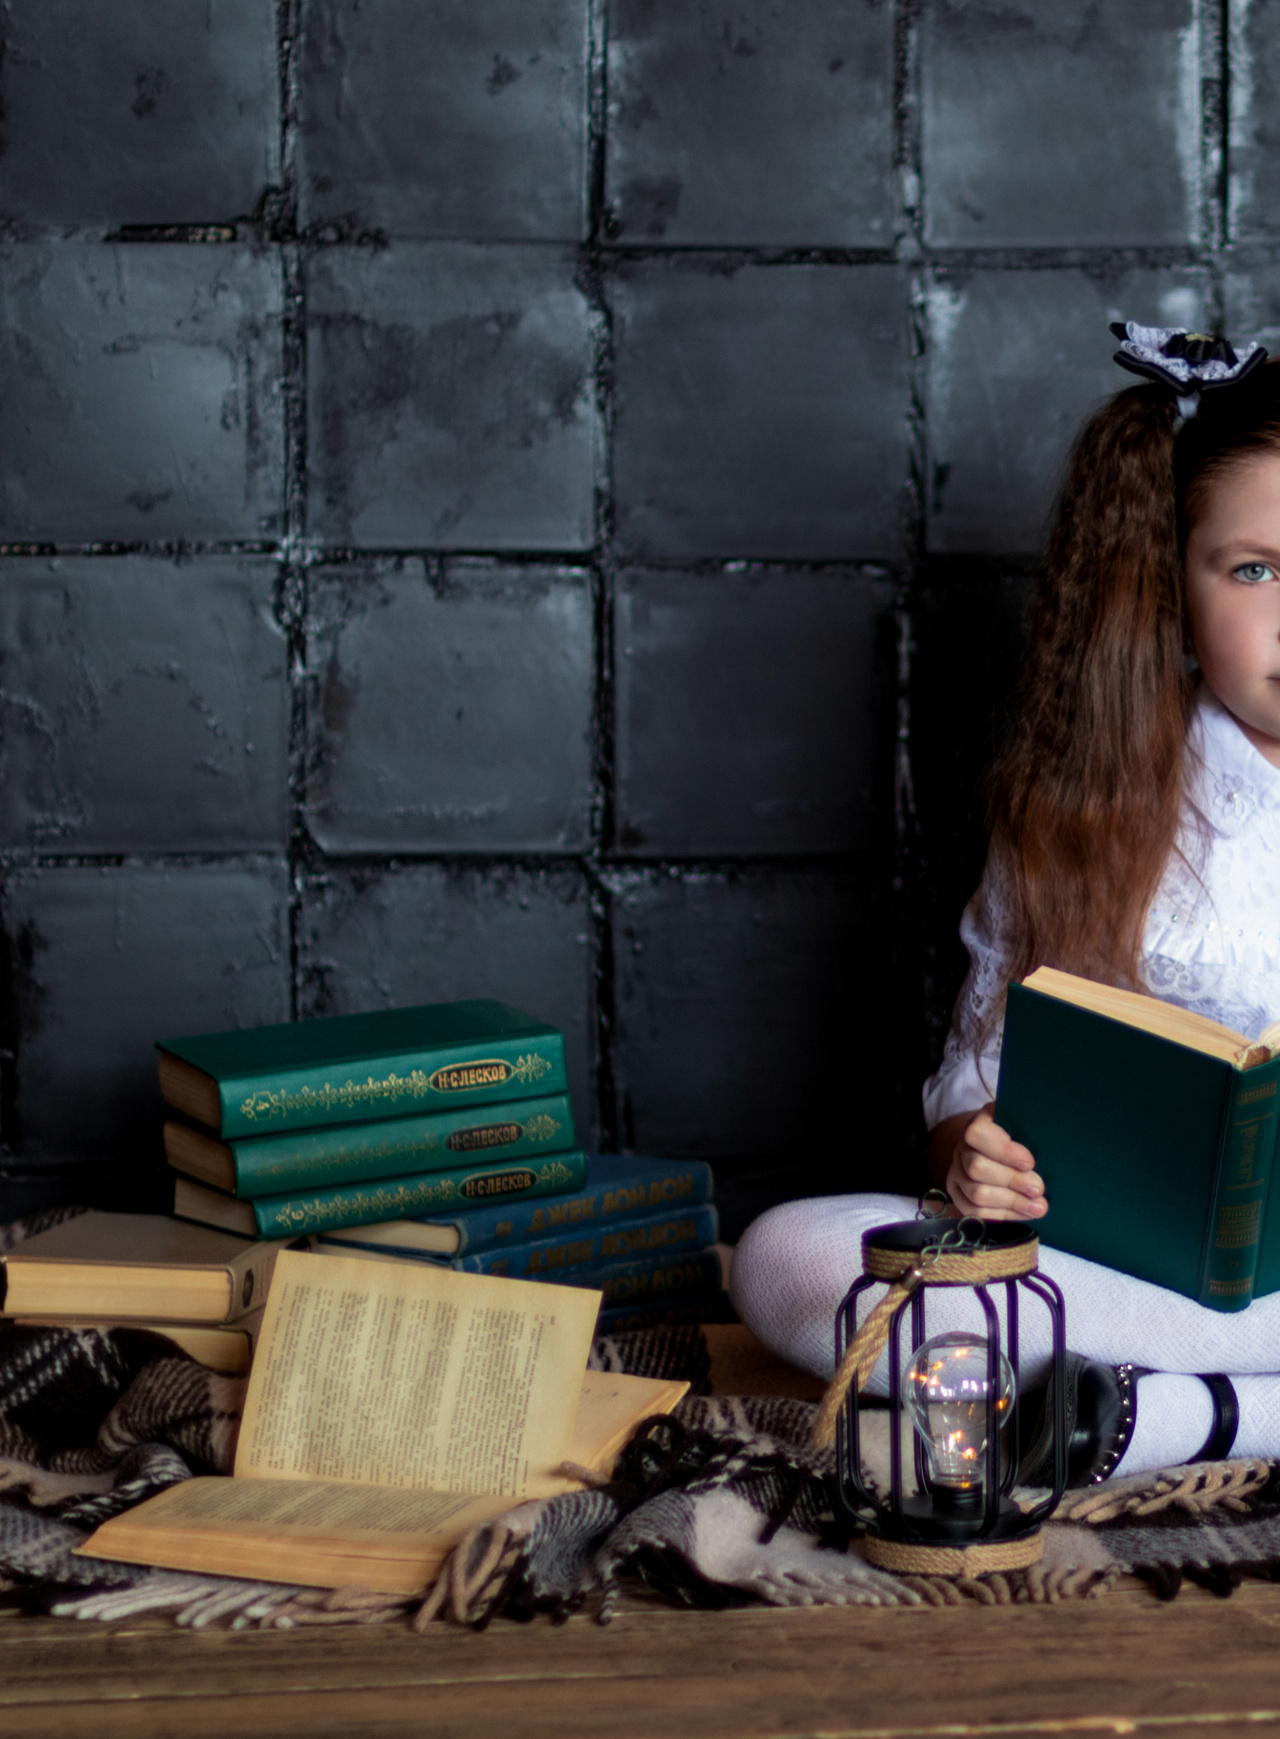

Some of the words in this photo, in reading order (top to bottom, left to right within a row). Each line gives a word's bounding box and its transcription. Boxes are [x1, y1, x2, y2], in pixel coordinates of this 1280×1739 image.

[527, 1196, 595, 1233] ДЖЕК
[602, 1173, 693, 1216] ЛОНДОН
[523, 1238, 593, 1276] ДЖЕК
[600, 1218, 696, 1259] ЛОНДОН
